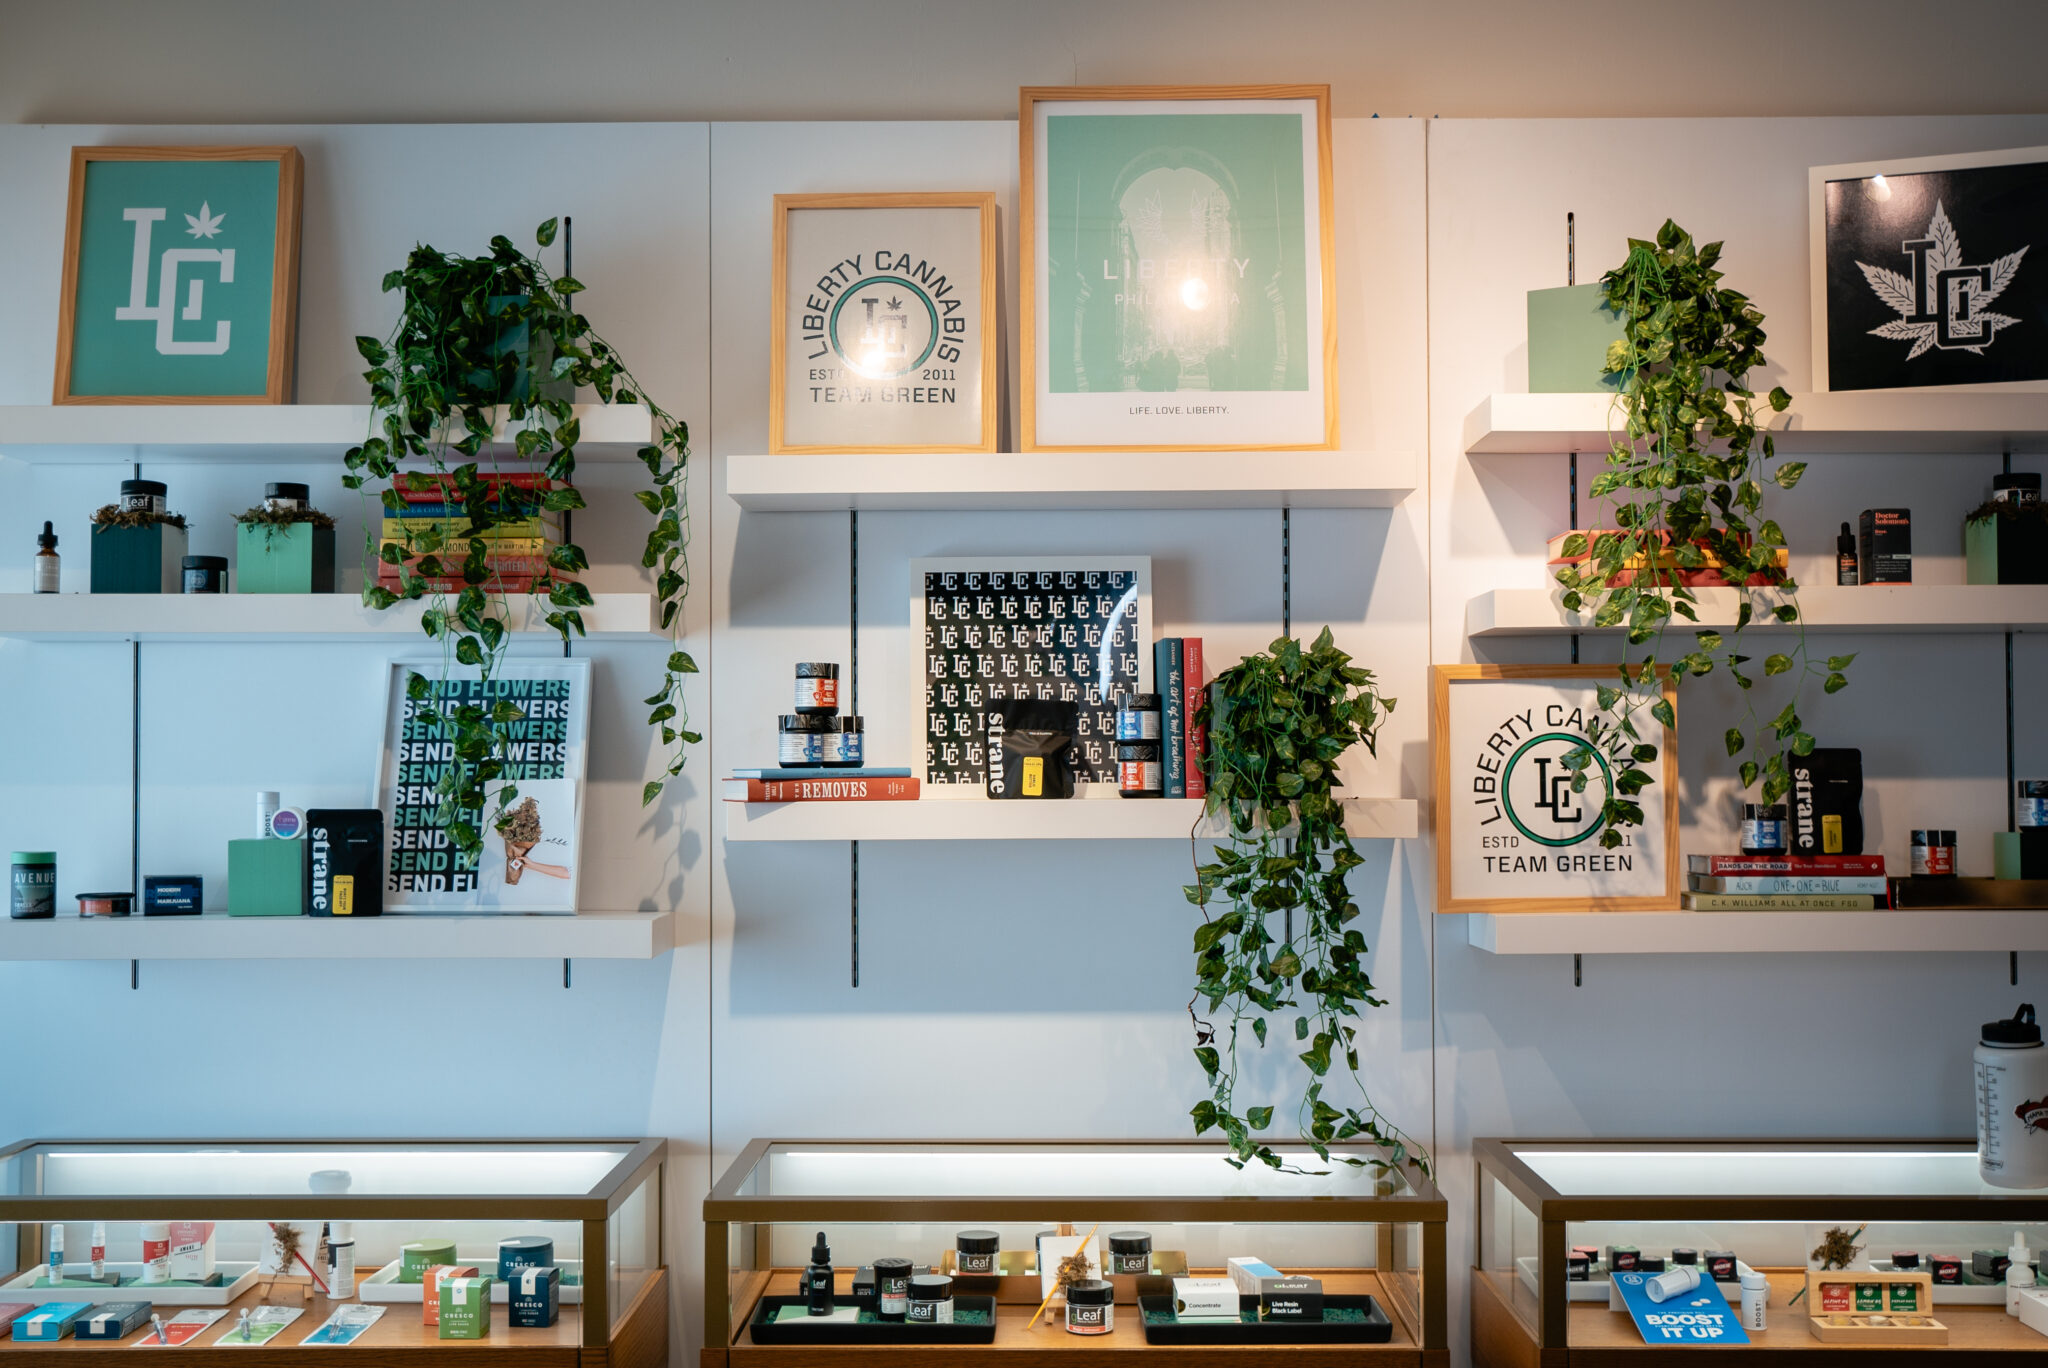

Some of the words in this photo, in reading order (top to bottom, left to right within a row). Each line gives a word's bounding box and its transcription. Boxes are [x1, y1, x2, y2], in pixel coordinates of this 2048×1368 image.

[115, 207, 236, 356] LC
[802, 254, 862, 360] LIBERTY
[875, 250, 966, 364] CANNABIS
[922, 369, 956, 380] 2011
[810, 388, 872, 402] TEAM
[881, 388, 956, 403] GREEN
[1129, 406, 1152, 414] LIFE.
[1156, 406, 1183, 414] LOVE.
[1186, 406, 1230, 414] LIBERTY.
[1170, 670, 1182, 686] the
[468, 680, 570, 697] FLOWERS
[1170, 686, 1182, 702] art
[1167, 704, 1182, 717] of
[402, 721, 458, 740] SEND
[1170, 718, 1182, 732] not
[400, 743, 456, 761] SEND
[988, 712, 1006, 794] strane
[1169, 736, 1184, 780] breathing
[1473, 708, 1533, 826] LIBERTY
[802, 782, 867, 798] REMOVES
[1794, 768, 1814, 848] strane
[392, 830, 449, 848] SEND
[1482, 836, 1519, 848] ESTD
[312, 828, 331, 910] strane
[390, 852, 448, 871] SEND
[1483, 856, 1548, 872] TEAM
[1556, 855, 1632, 872] GREEN
[14, 872, 55, 884] AVENUE
[388, 874, 446, 892] SEND
[1773, 880, 1790, 892] ONE
[1796, 880, 1814, 892] ONE
[961, 1256, 990, 1272] gLeaf
[1116, 1256, 1146, 1272] gLeaf
[1938, 1267, 1958, 1276] MOXIE
[1071, 1308, 1102, 1324] gLeaf
[1645, 1314, 1724, 1326] BOOST
[1662, 1328, 1684, 1338] IT
[1690, 1328, 1724, 1338] UP
